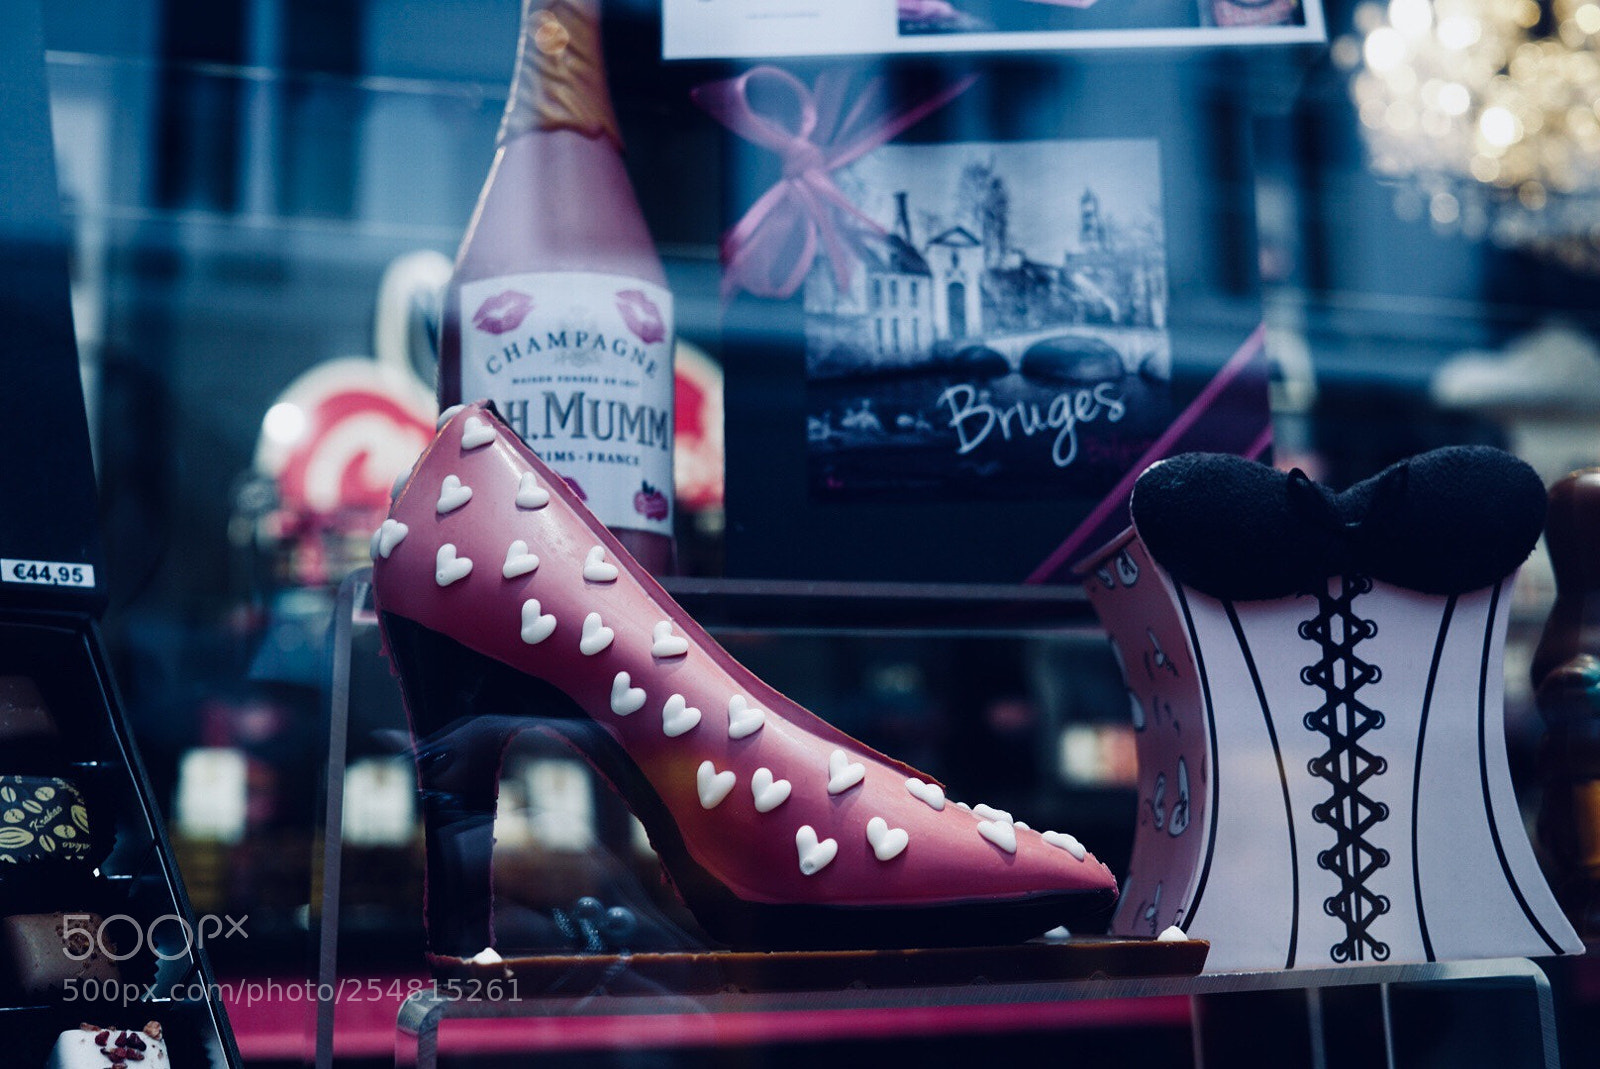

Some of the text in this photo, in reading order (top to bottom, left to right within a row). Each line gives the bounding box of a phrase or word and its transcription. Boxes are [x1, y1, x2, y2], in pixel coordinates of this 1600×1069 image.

[486, 331, 658, 377] CHAMPAGNE
[937, 383, 1125, 467] Bruges
[586, 451, 639, 466] FRANCE
[13, 563, 84, 585] €44,95
